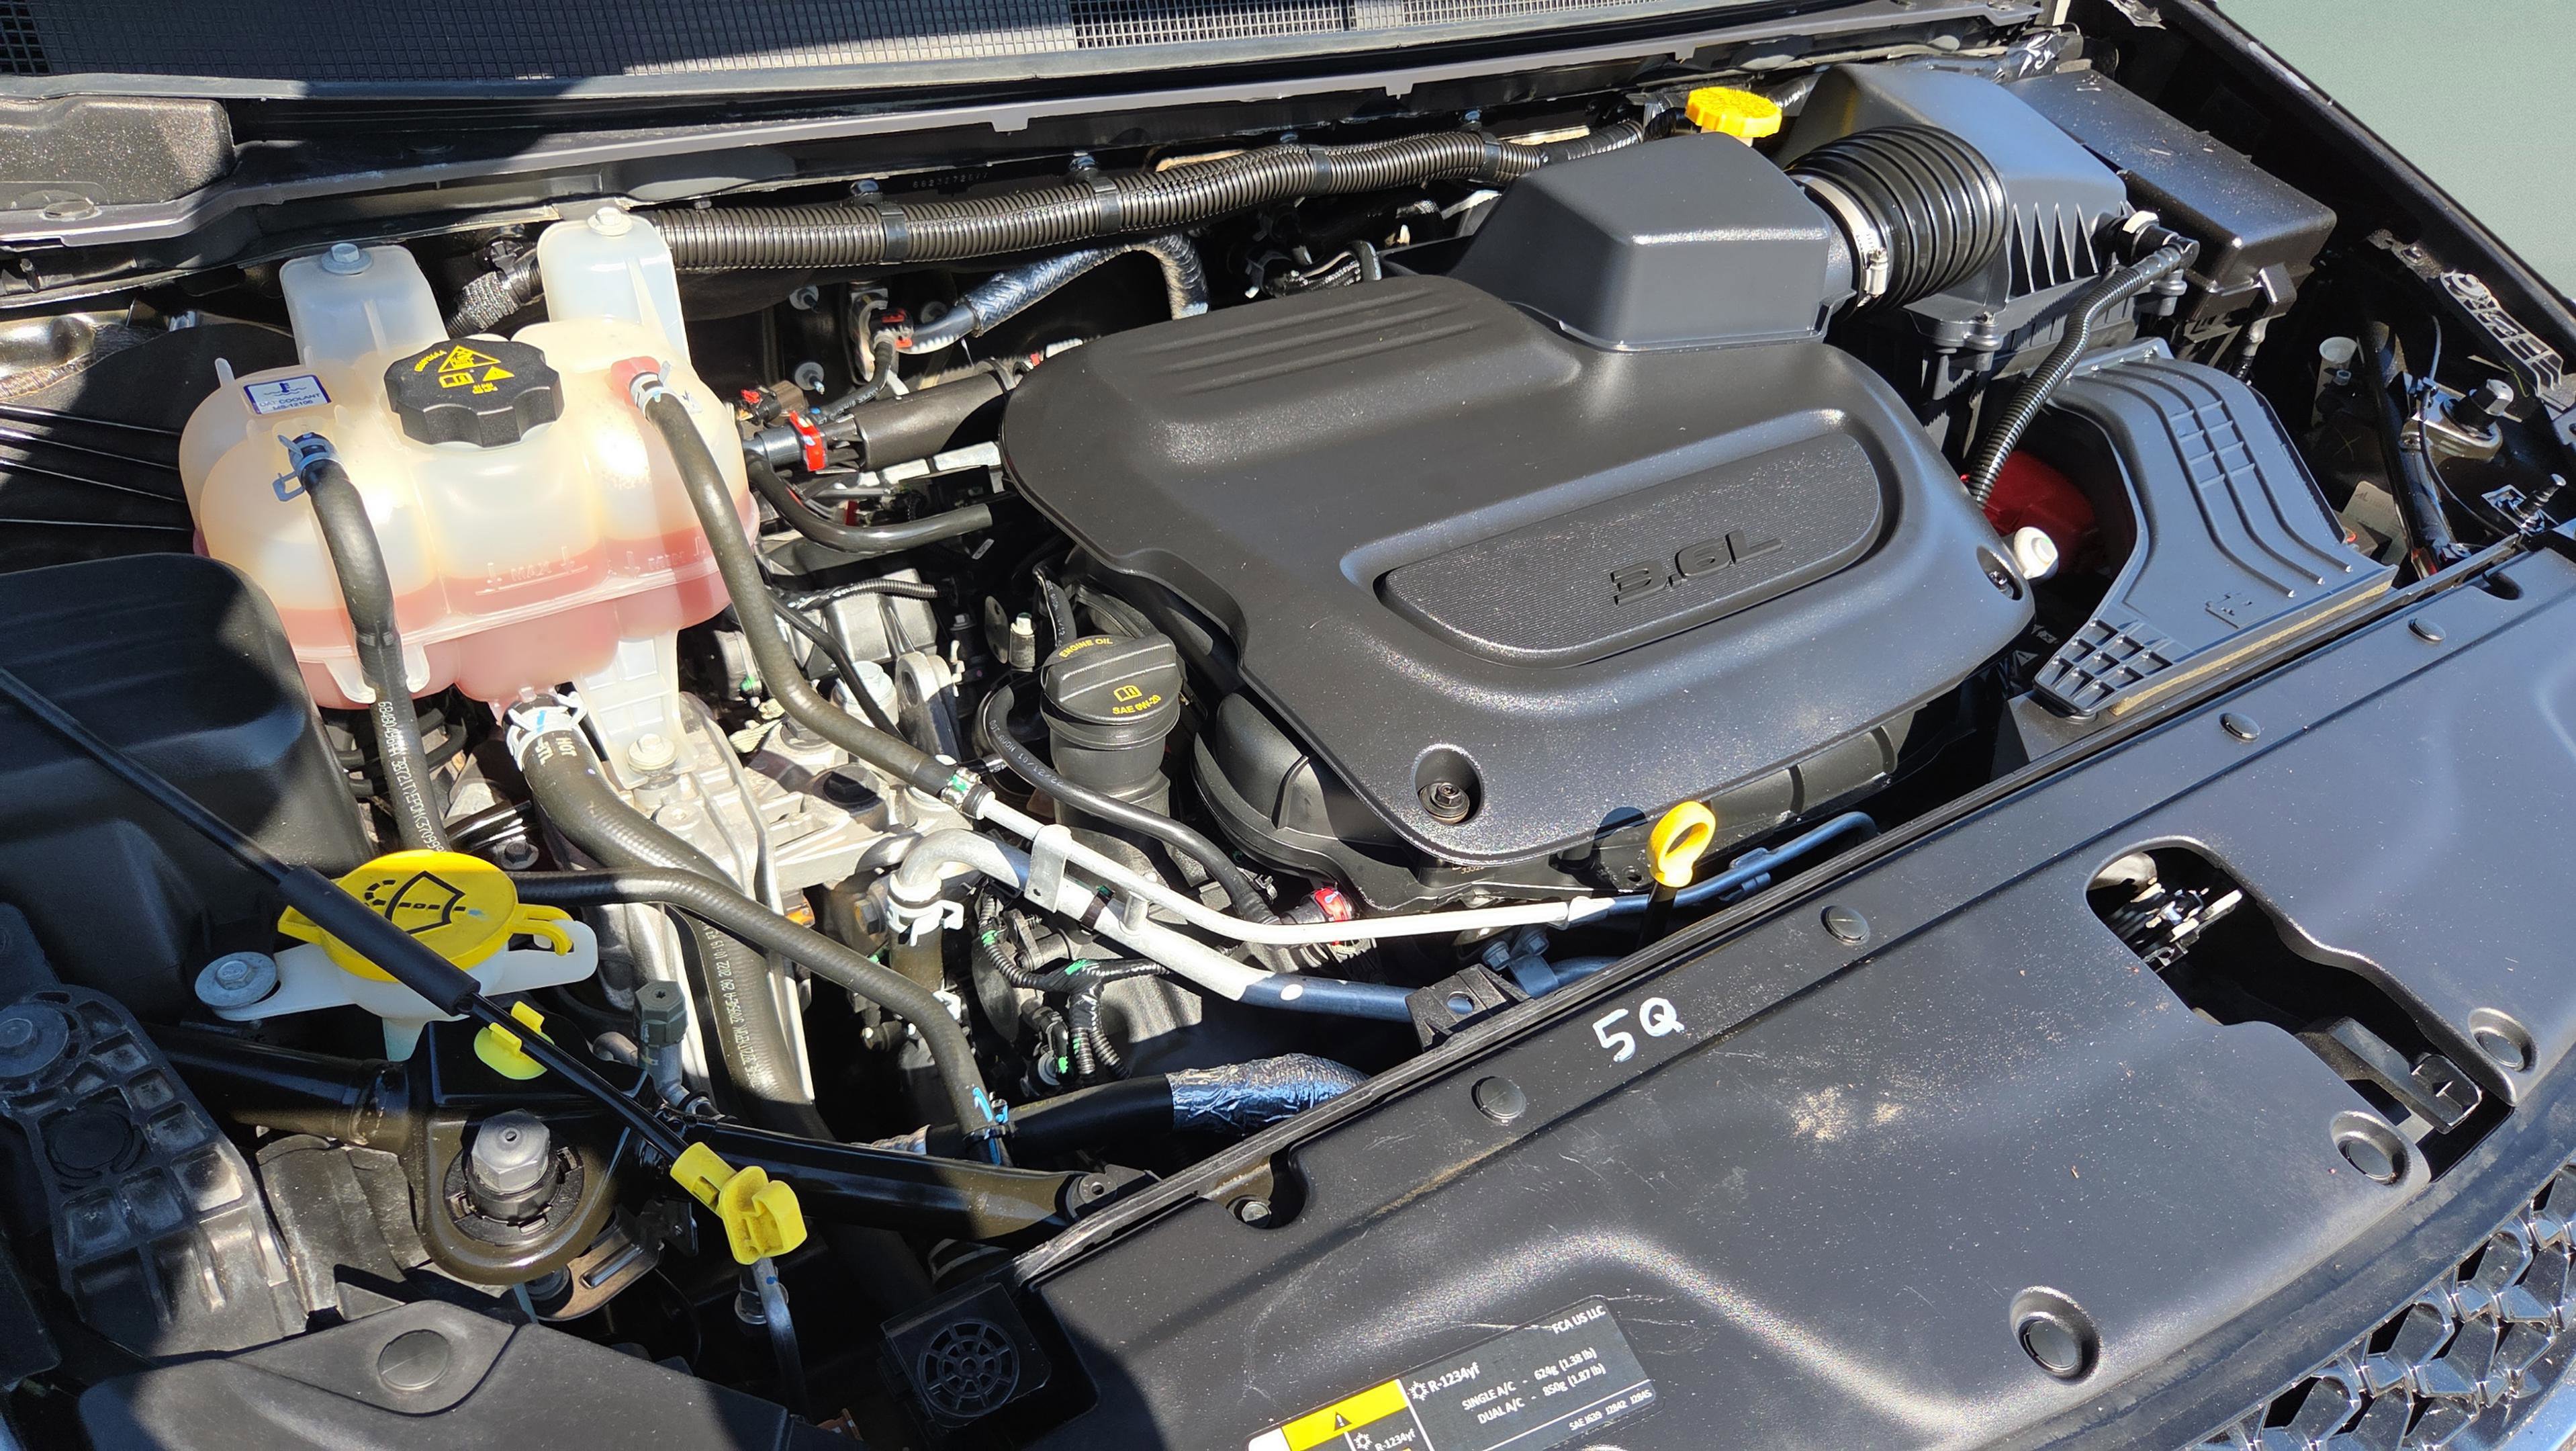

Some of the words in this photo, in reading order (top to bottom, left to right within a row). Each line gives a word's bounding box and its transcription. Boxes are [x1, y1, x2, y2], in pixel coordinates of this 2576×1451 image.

[279, 393, 320, 404] COOLANT
[510, 560, 553, 582] MAX
[1610, 529, 1783, 605] 3.6L
[1058, 640, 1095, 659] ENGINE
[1096, 637, 1114, 646] OIL
[1112, 705, 1136, 715] SAE
[1135, 694, 1162, 712] 0W-20
[555, 737, 578, 757] HOT
[1551, 1319, 1574, 1335] FCA
[1571, 1312, 1588, 1326] US
[1585, 1305, 1606, 1321] LLC
[1427, 1361, 1480, 1393] R-1234yf
[1462, 1389, 1498, 1411] SINGLE
[1496, 1380, 1517, 1396] A/C
[1534, 1365, 1559, 1380] 624g
[1558, 1353, 1583, 1372] (1.38
[1581, 1347, 1598, 1361] lb)
[1477, 1405, 1507, 1424] DUAL
[1505, 1397, 1526, 1412] A/C
[1542, 1380, 1569, 1397] 850g
[1567, 1368, 1592, 1388] (1.87
[1590, 1362, 1606, 1377] lb)
[1569, 1418, 1586, 1431] SAE
[1374, 1427, 1416, 1451] R-1234yf
